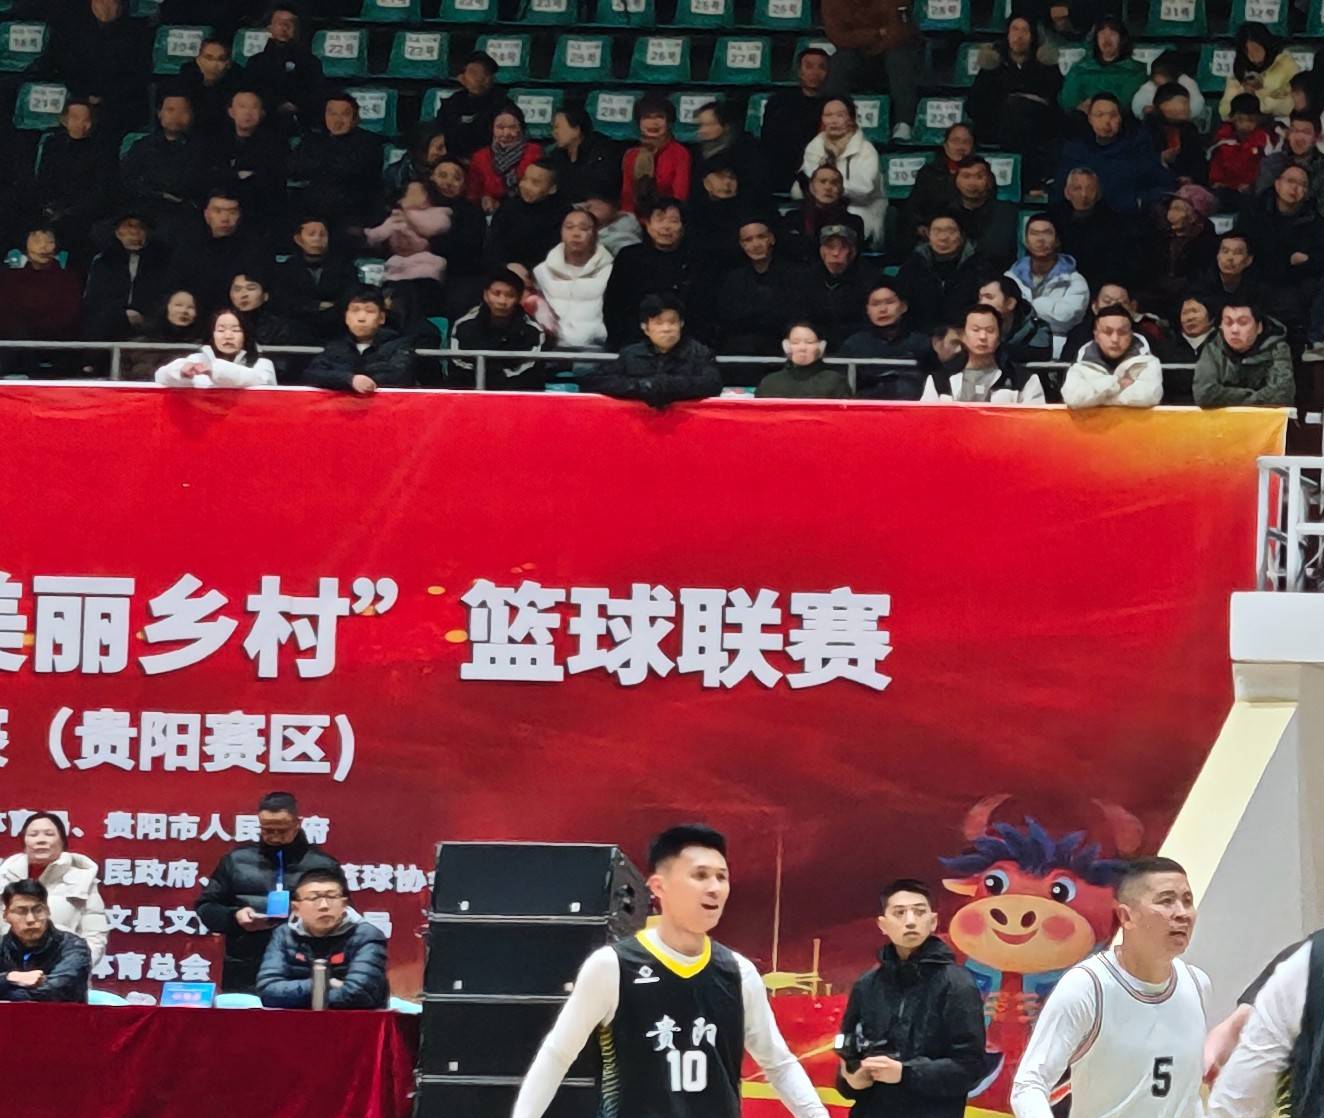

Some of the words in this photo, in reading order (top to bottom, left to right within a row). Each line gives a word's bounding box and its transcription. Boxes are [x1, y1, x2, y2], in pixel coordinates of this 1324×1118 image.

[0, 572, 398, 679] 丽乡村”
[460, 579, 892, 690] 篮球联赛
[104, 811, 330, 845] 贵阳市人民府
[106, 904, 209, 936] 文县文
[665, 1050, 708, 1092] 10
[1151, 1055, 1174, 1098] 5
